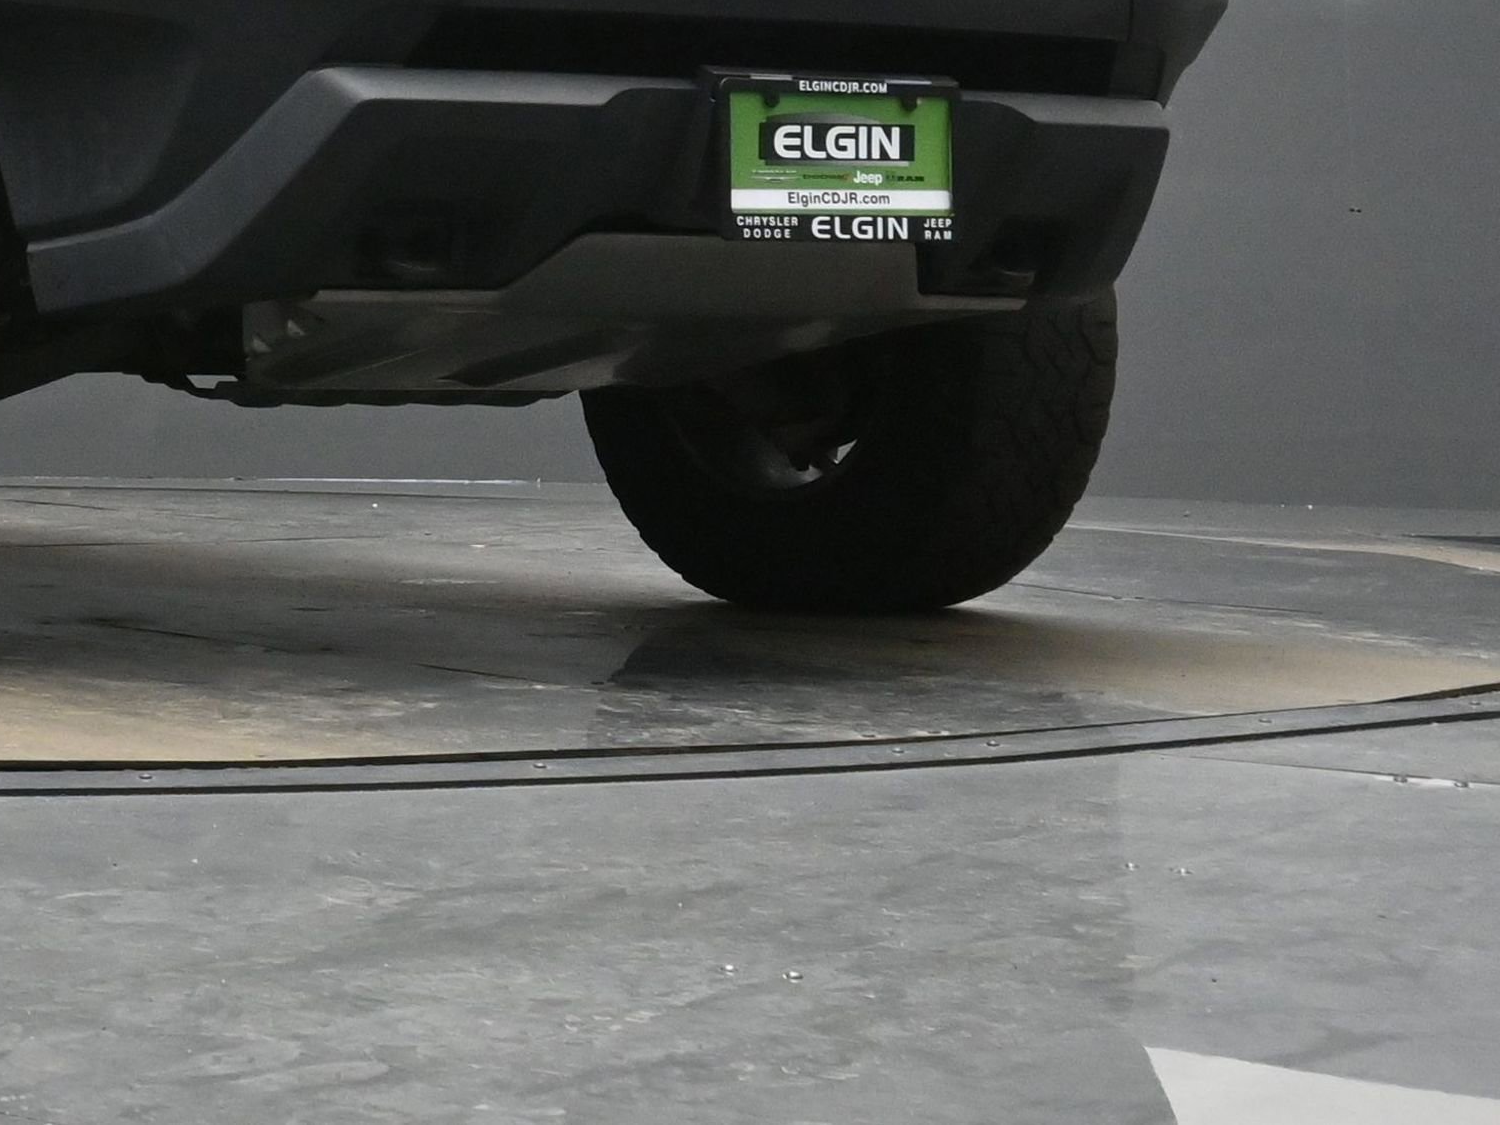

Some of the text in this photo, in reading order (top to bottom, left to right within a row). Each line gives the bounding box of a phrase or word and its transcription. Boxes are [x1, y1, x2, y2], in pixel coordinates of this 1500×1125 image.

[799, 80, 888, 94] ELGINCDJR.COM
[773, 125, 901, 160] ELGIN
[853, 170, 883, 186] Jeep
[787, 192, 890, 207] ElginCDJR.com
[736, 216, 798, 226] CHRYSLER
[811, 216, 909, 239] ELGIN
[924, 218, 952, 228] JEEP
[743, 228, 791, 238] DODGE
[925, 231, 952, 240] RAM
